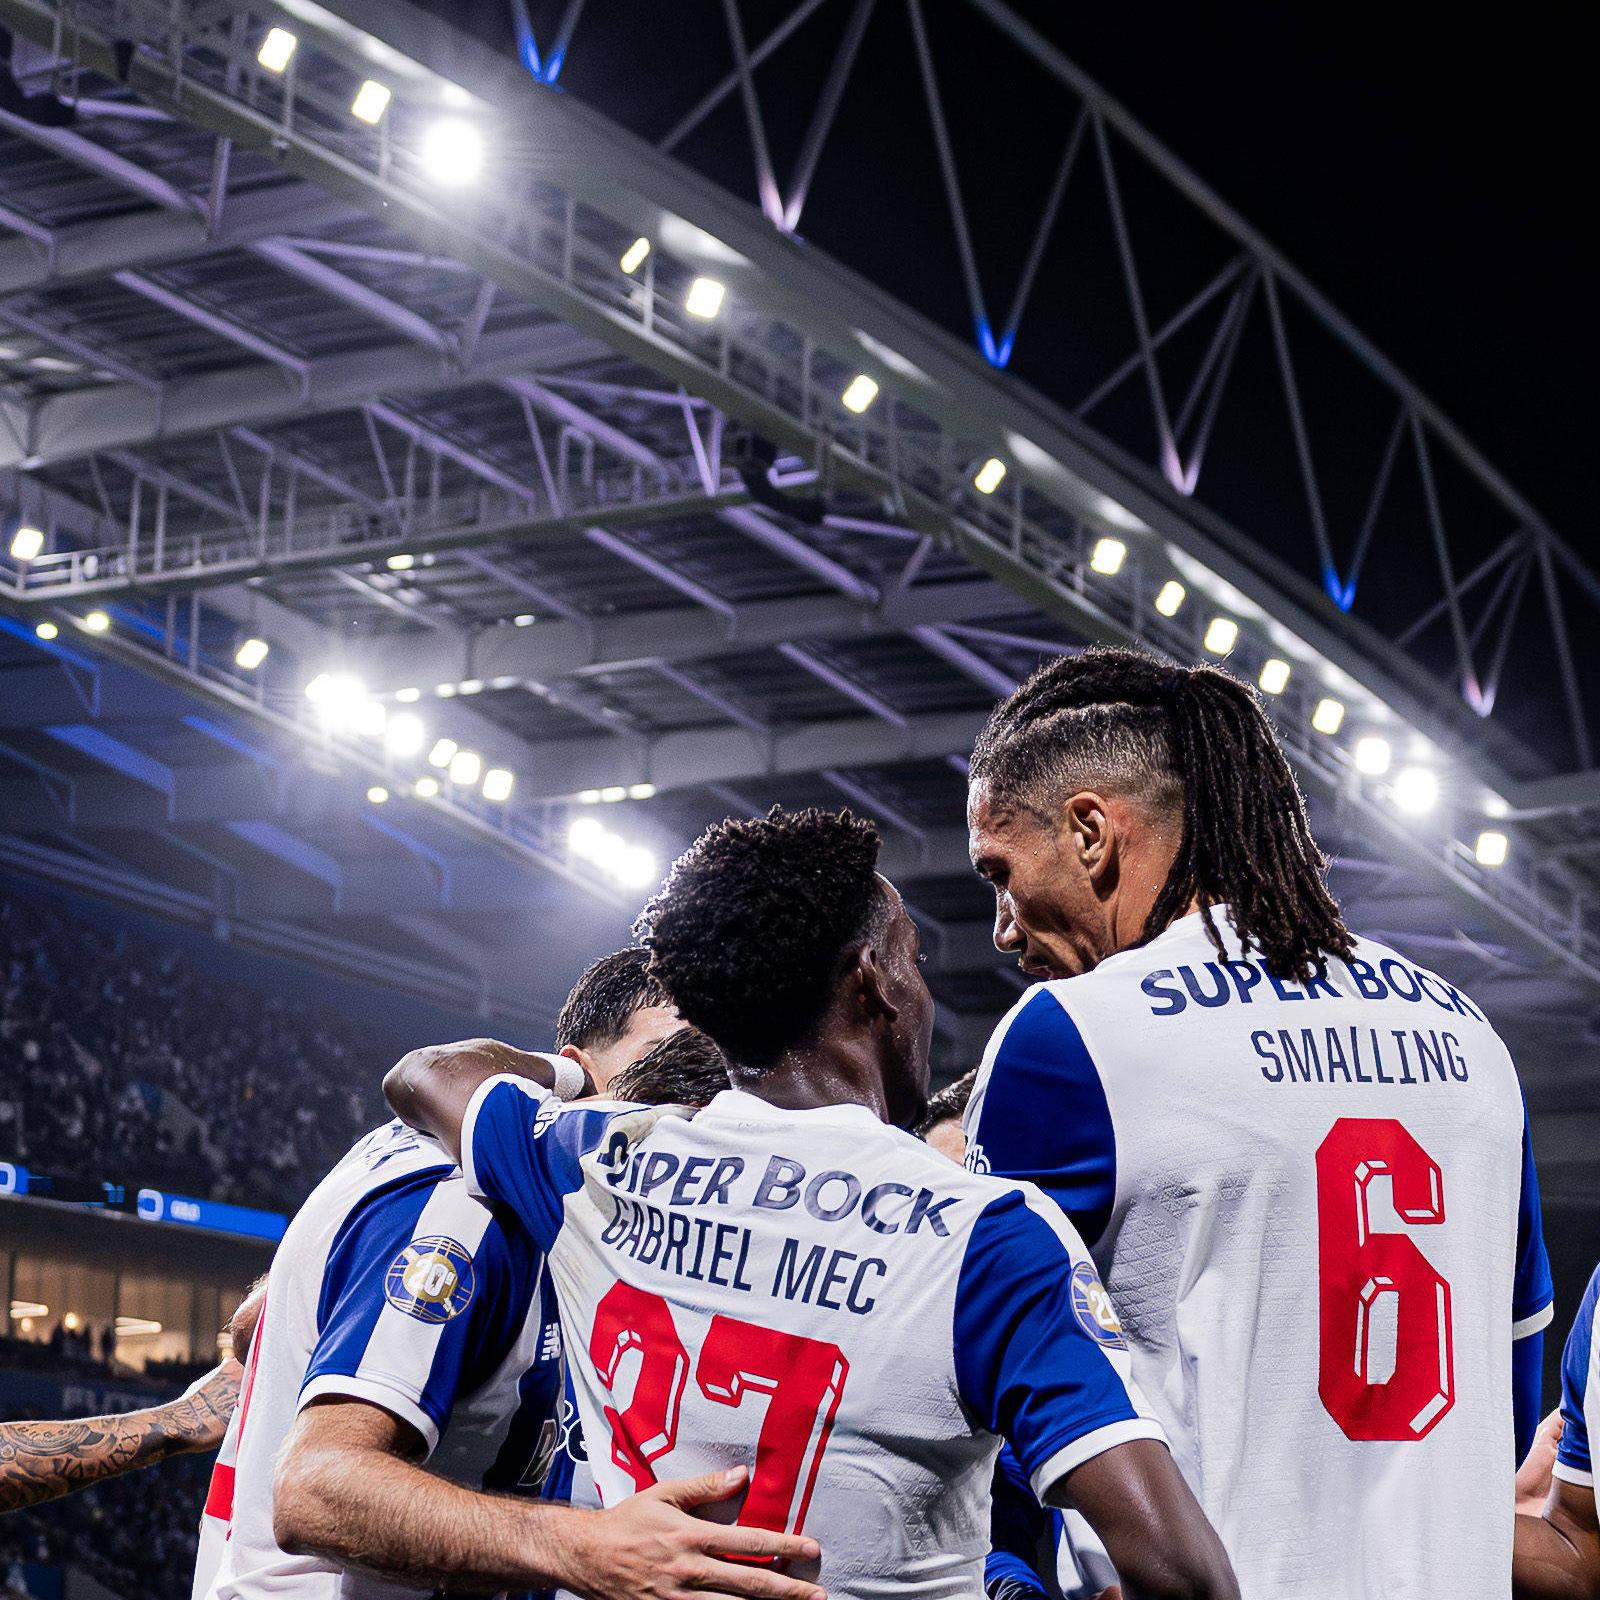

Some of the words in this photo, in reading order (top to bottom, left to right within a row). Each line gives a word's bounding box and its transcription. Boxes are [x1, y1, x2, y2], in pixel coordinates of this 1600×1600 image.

[1140, 958, 1343, 1016] SUPER
[1347, 957, 1483, 1022] BOCK
[1251, 1026, 1469, 1084] SMALLING
[752, 1154, 964, 1237] BOCK
[601, 1195, 752, 1293] GABRIEL
[771, 1237, 887, 1316] MEC
[1315, 1117, 1456, 1441] 6
